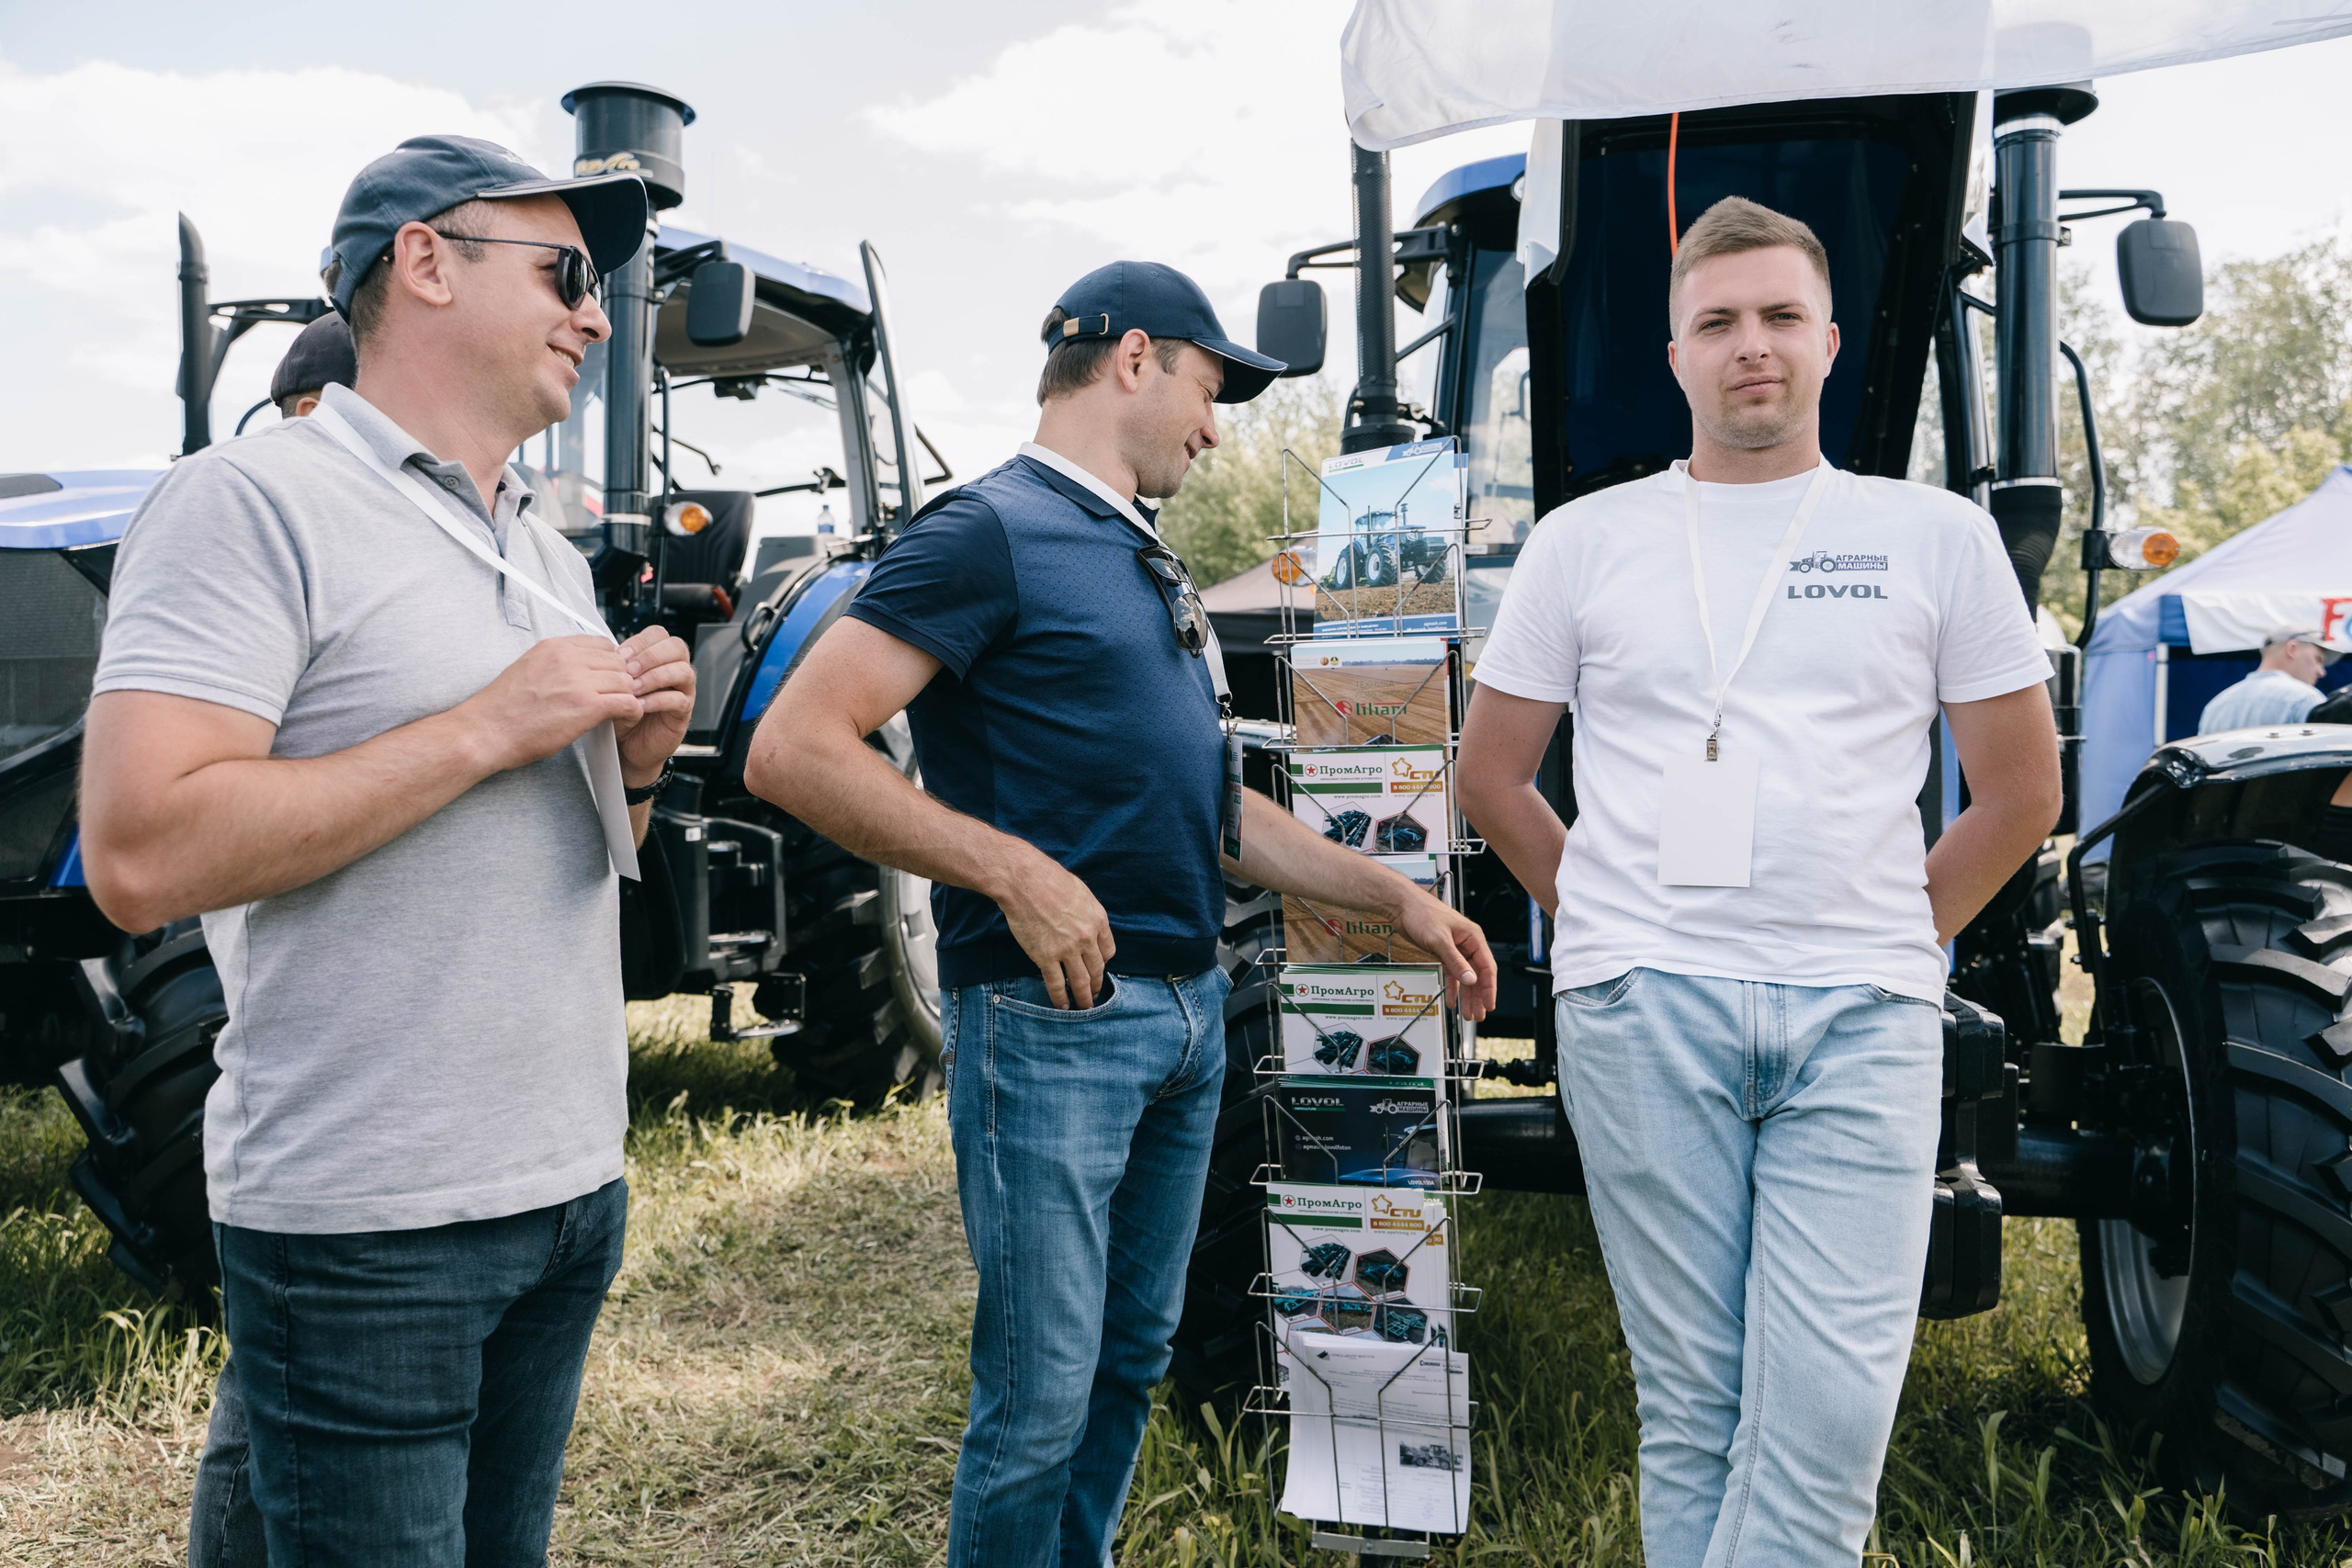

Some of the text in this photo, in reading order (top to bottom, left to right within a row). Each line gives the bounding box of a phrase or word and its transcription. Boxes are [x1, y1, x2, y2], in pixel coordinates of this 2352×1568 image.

[1838, 562, 1886, 570] МАШИНЫ
[1788, 585, 1888, 599] LOVOL
[1319, 765, 1383, 776] ПромАгро
[1311, 986, 1374, 998] ПромАгро
[1291, 1097, 1344, 1107] LOVOL
[1297, 1197, 1363, 1210] ПромАгро
